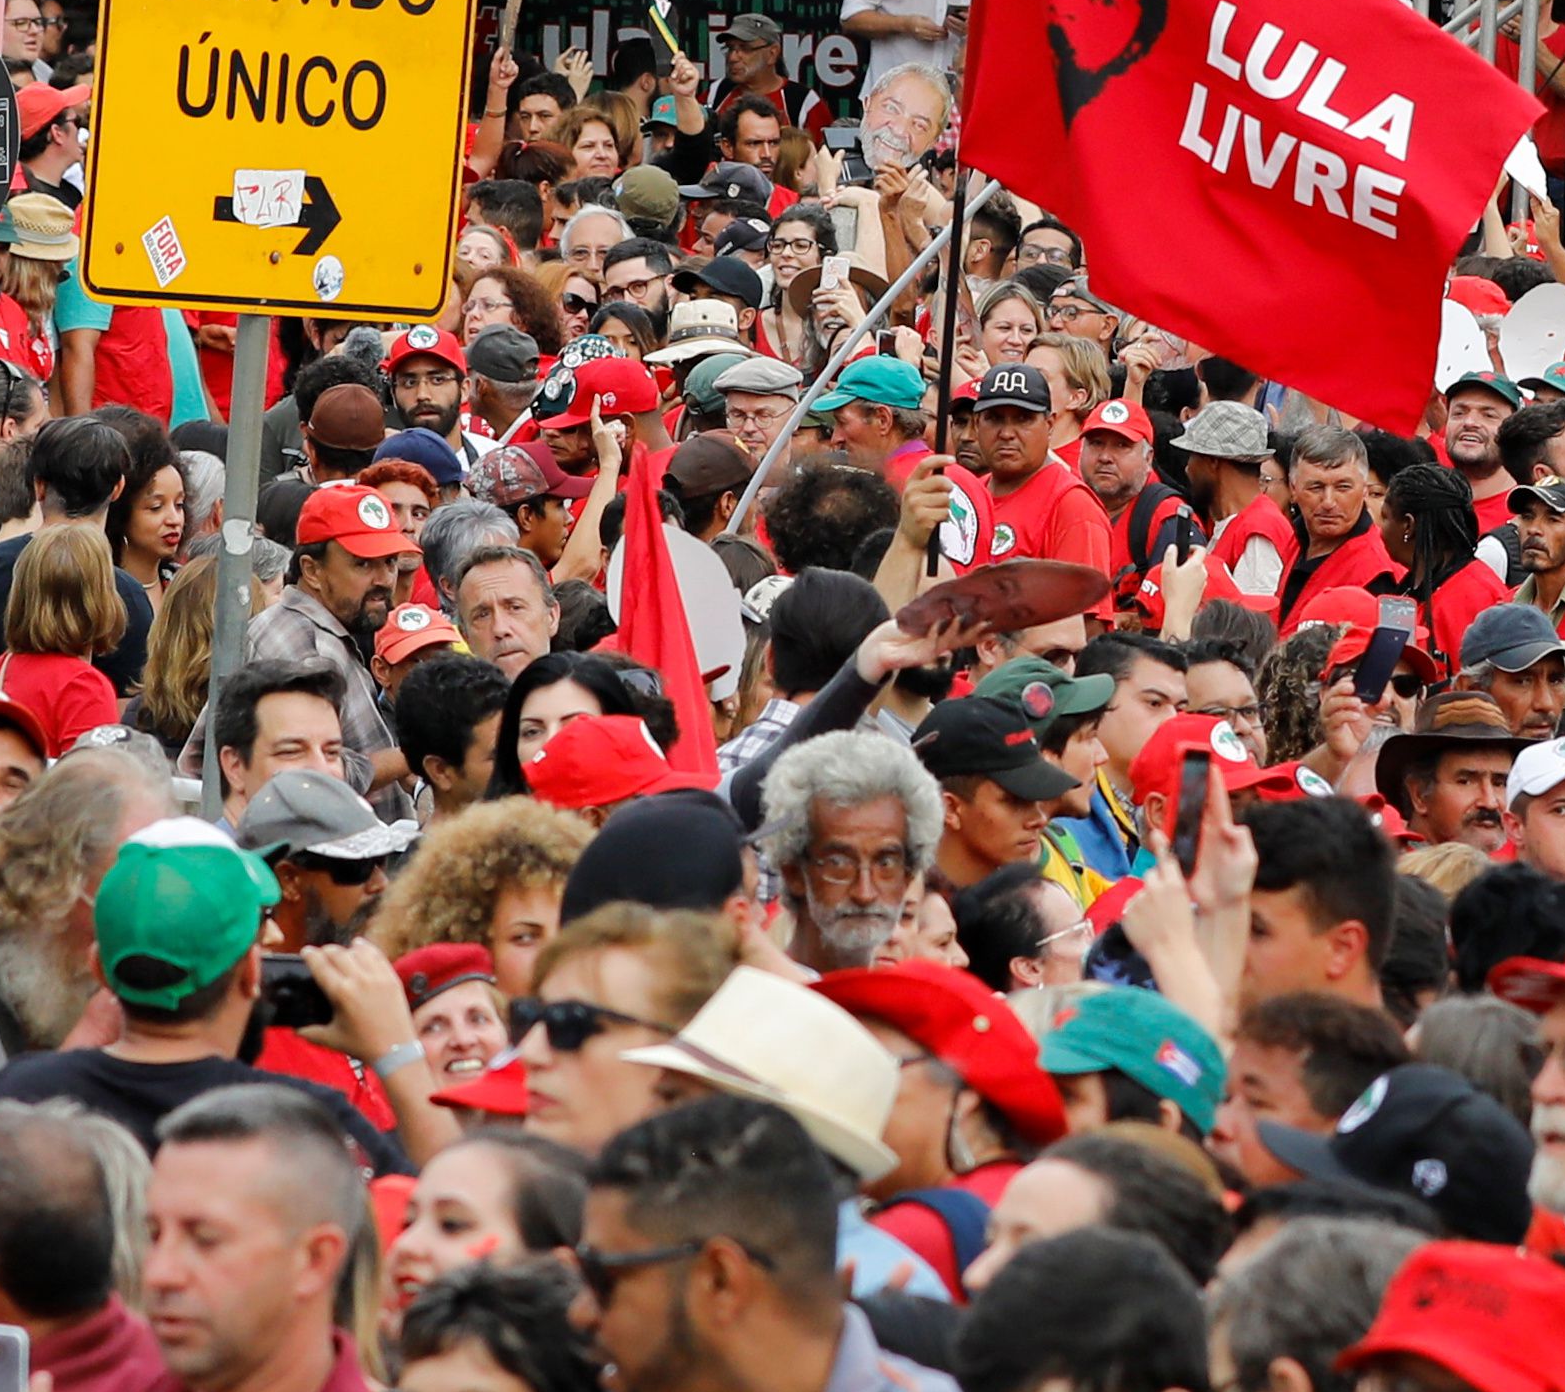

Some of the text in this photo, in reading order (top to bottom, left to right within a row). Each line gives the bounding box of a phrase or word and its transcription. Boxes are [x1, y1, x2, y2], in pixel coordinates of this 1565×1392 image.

[177, 31, 387, 131] ÚNICO
[1206, 0, 1416, 161] LULA
[1179, 81, 1407, 239] LIVRE
[151, 218, 184, 277] FORA
